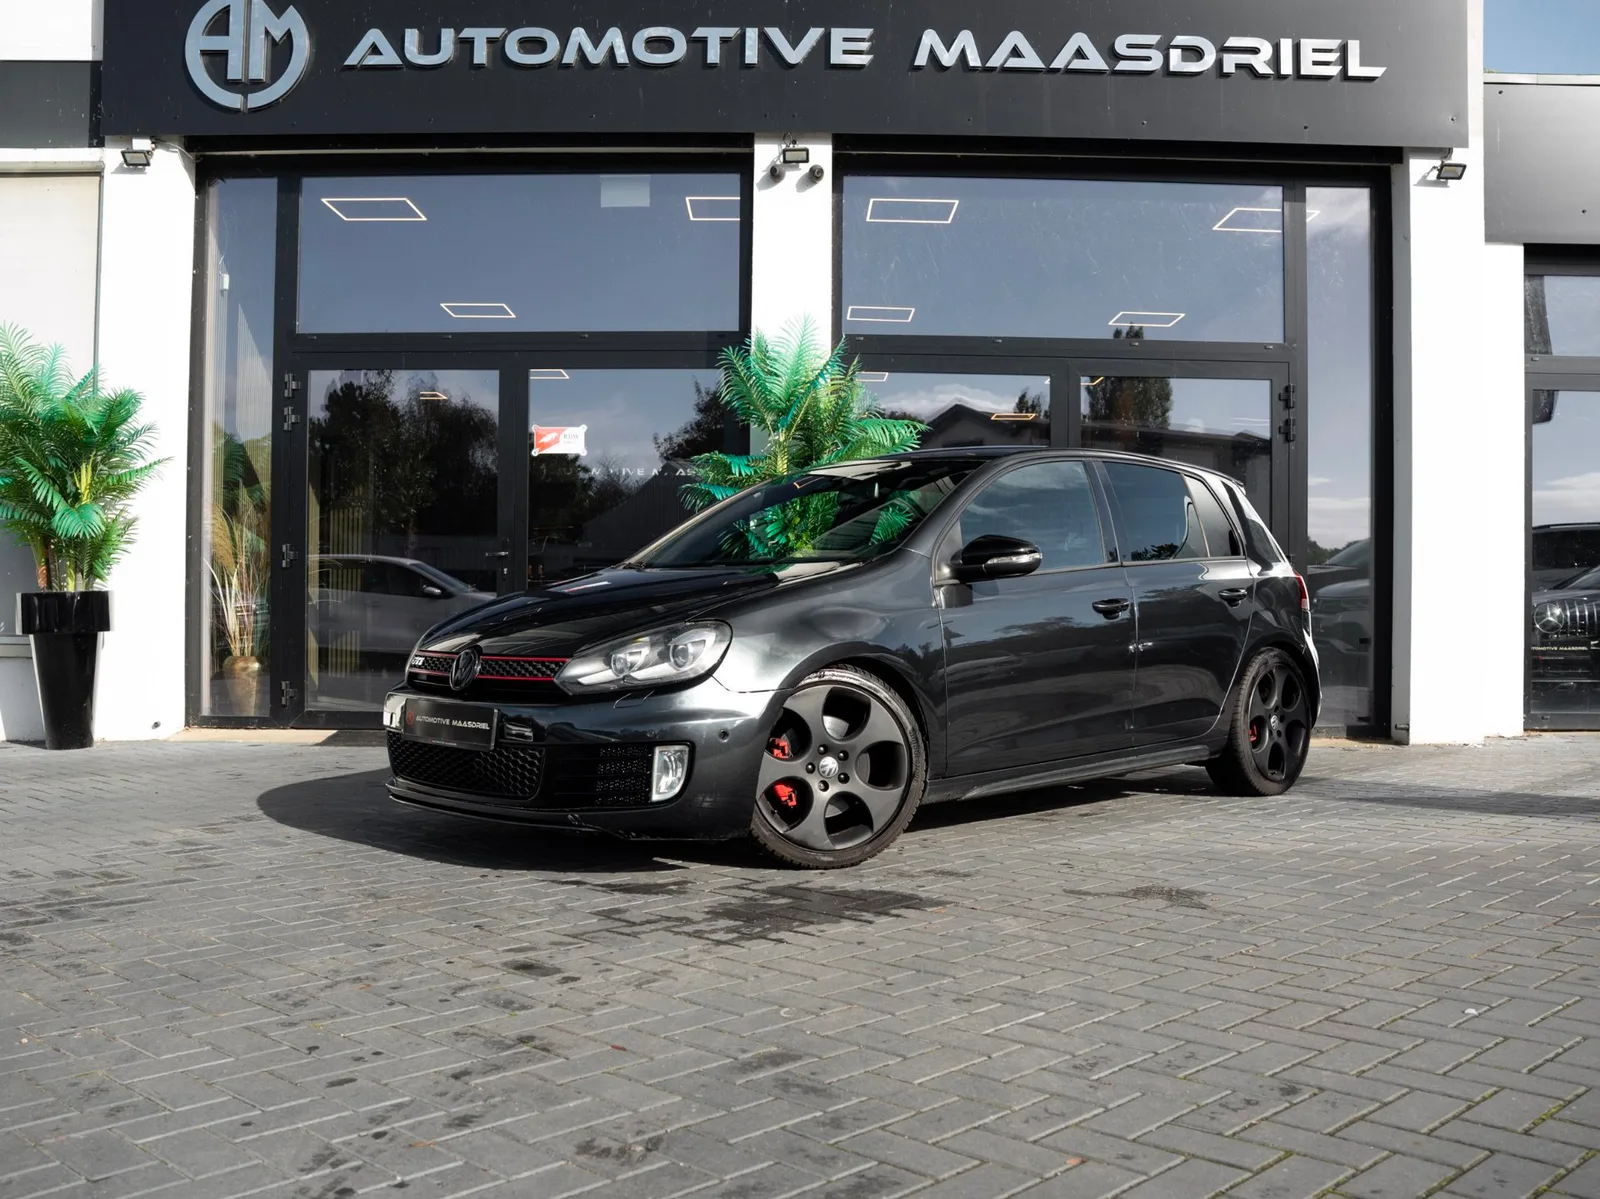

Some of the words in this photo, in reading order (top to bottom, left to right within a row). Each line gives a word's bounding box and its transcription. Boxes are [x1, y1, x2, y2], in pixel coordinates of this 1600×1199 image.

[343, 26, 875, 68] AUTOMOTIVE
[912, 28, 1388, 80] MAASDRIEL
[415, 715, 450, 725] AUTOMOTIVE
[451, 720, 490, 730] MAASDRIEL
